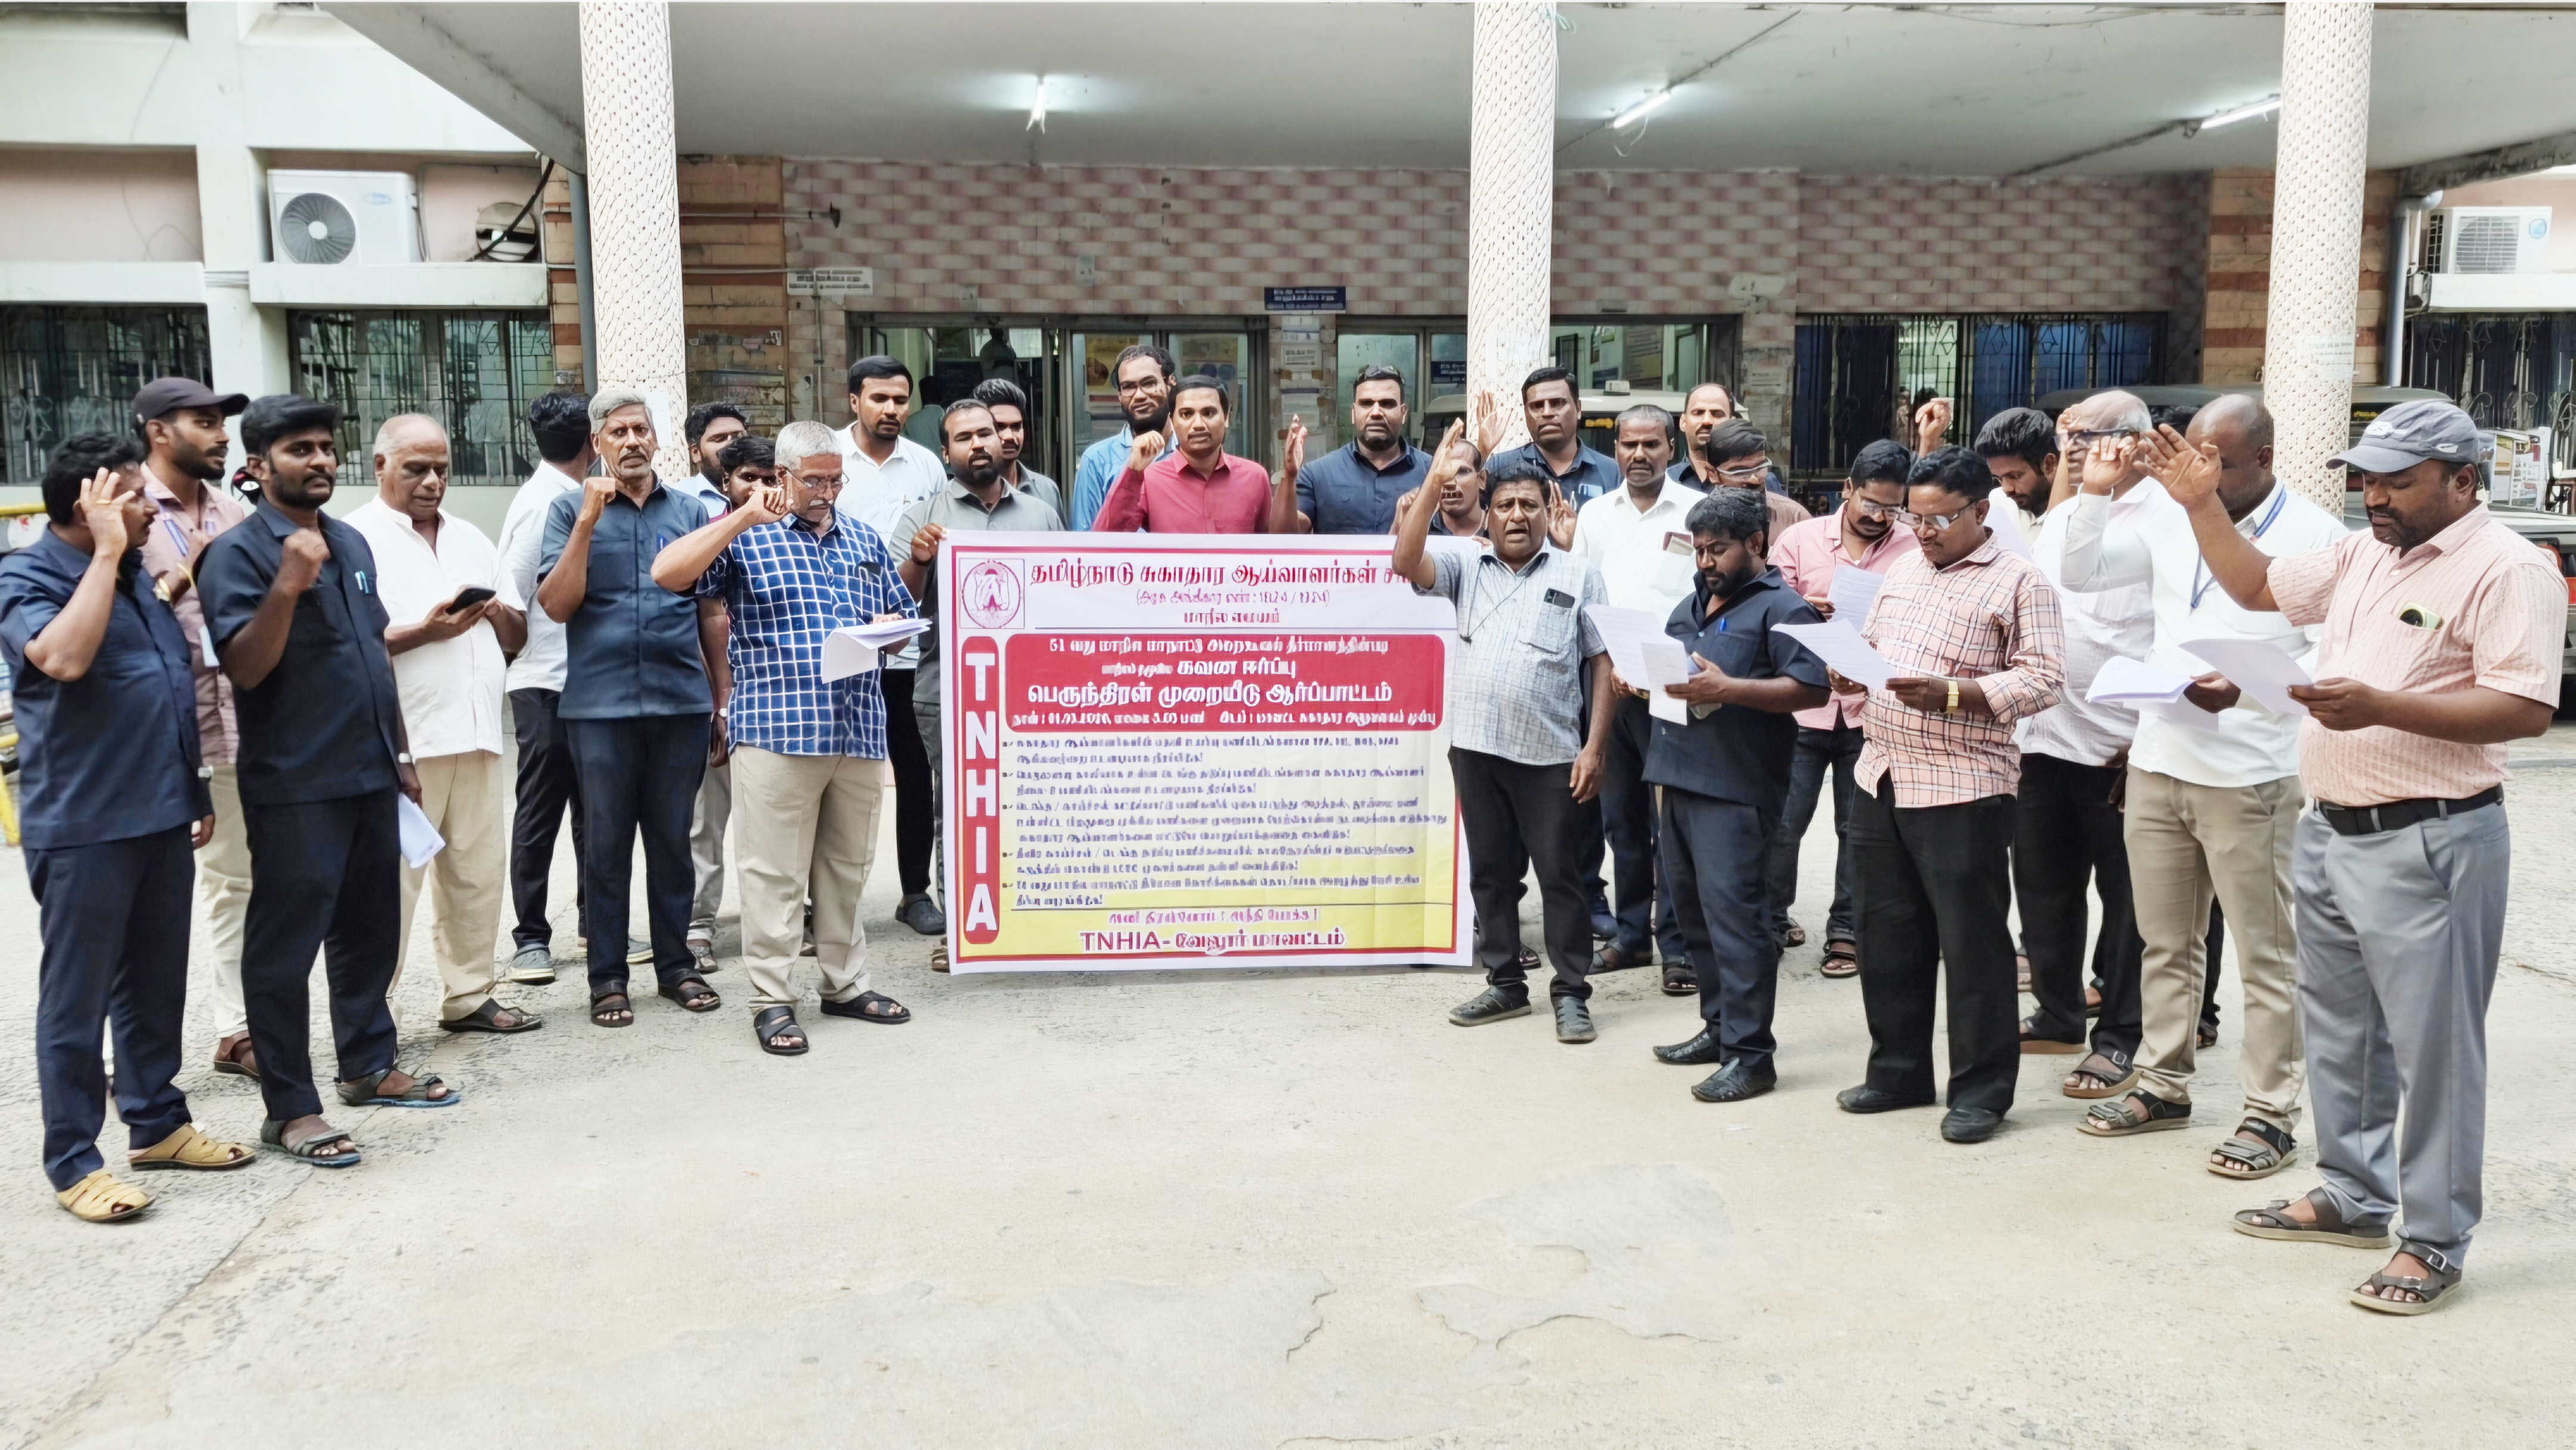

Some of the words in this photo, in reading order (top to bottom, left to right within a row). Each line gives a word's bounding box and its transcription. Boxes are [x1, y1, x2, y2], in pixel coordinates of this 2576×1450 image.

[1176, 660, 1238, 676] கவன
[1242, 656, 1296, 678] ஈர்ப்பு
[1027, 681, 1153, 708] பெருந்திரள்
[1158, 678, 1261, 708] முறையீடு
[1265, 681, 1393, 706] ஆர்ப்பாட்டம்
